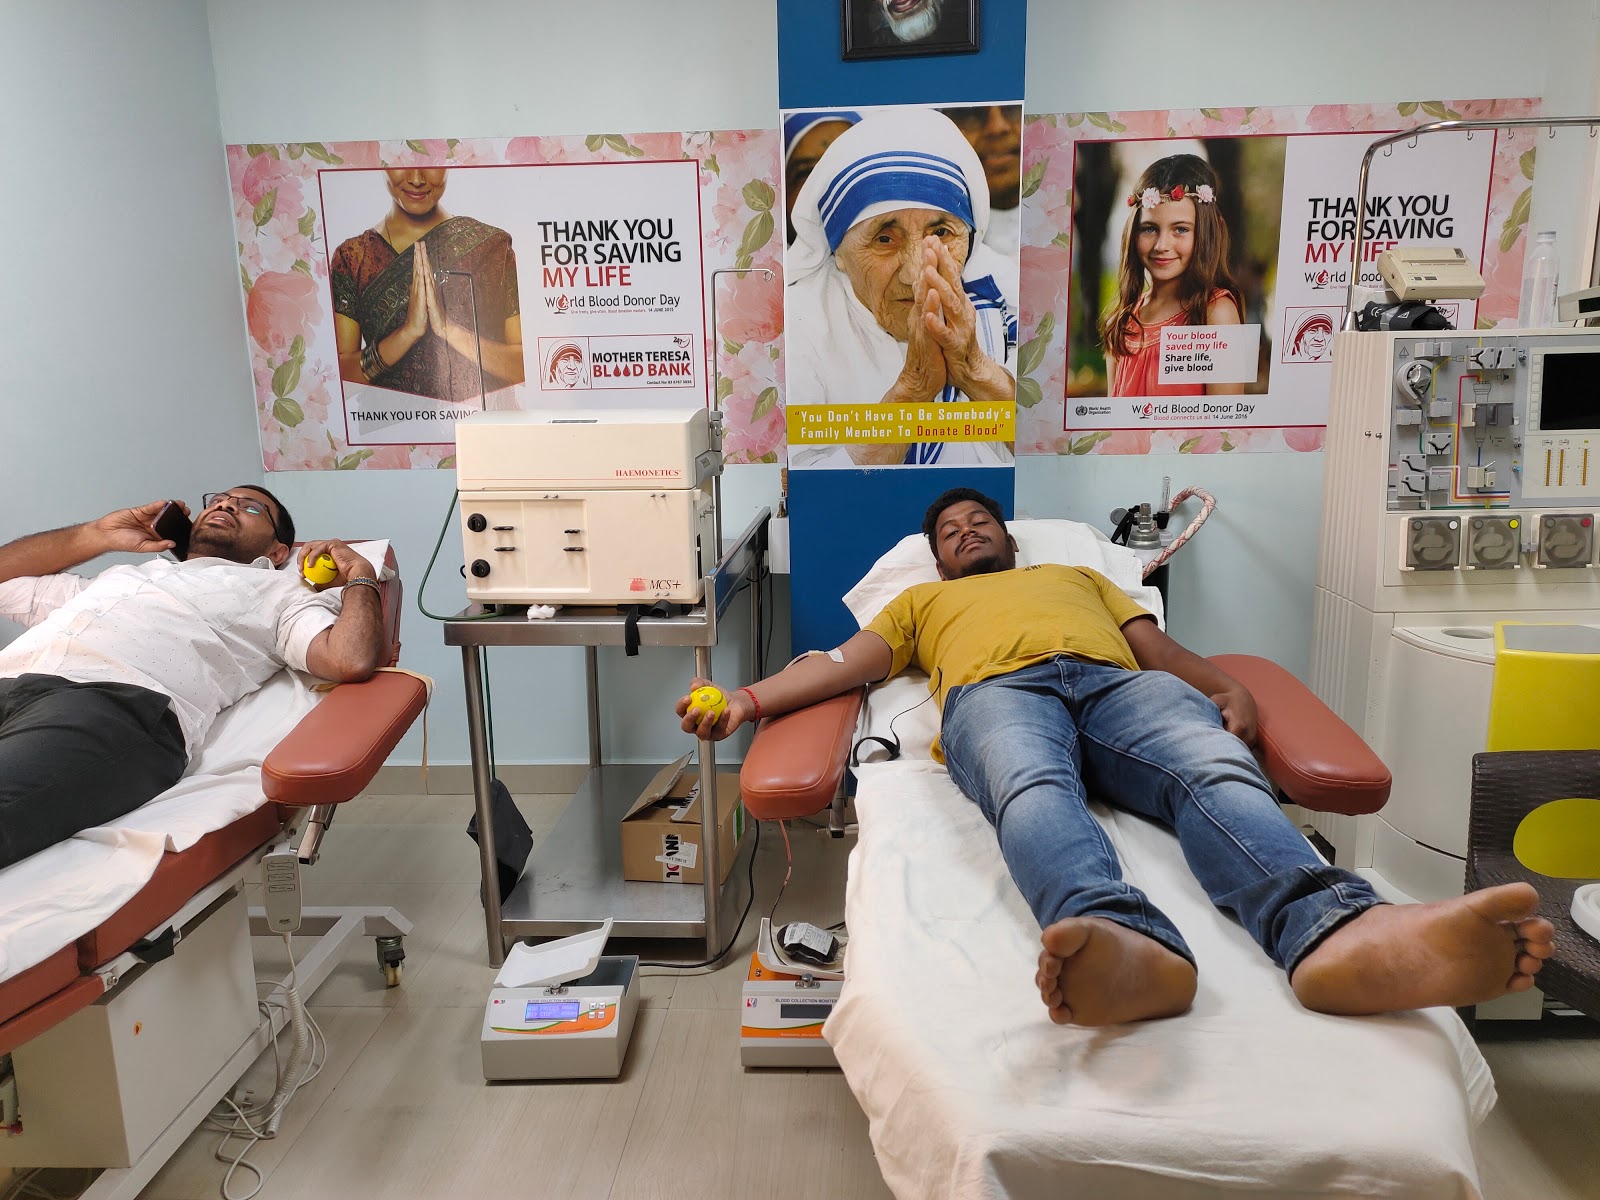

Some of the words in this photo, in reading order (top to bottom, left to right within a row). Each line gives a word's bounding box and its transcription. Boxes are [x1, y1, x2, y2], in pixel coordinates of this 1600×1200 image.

[1308, 195, 1393, 219] THANK
[1398, 194, 1449, 216] YOU
[537, 220, 620, 242] THANK
[623, 218, 673, 240] YOU
[1307, 220, 1356, 241] FOR
[1362, 217, 1454, 240] SAVING
[541, 244, 588, 265] FOR
[594, 241, 681, 264] SAVING
[1305, 242, 1344, 263] MY
[543, 266, 578, 288] MY
[585, 265, 632, 287] LIFE
[1359, 272, 1383, 282] ood
[589, 295, 620, 307] Blood
[624, 294, 656, 306] Donor
[659, 294, 681, 307] Day
[1166, 332, 1189, 341] Your
[1191, 331, 1217, 340] blood
[1165, 342, 1194, 350] saved
[1196, 343, 1210, 352] my
[1213, 341, 1228, 350] life
[592, 351, 643, 363] MOTHER
[645, 350, 690, 362] TERESA
[1165, 353, 1192, 362] Share
[1194, 352, 1212, 363] life,
[648, 362, 692, 376] BANK
[1164, 363, 1184, 374] give
[1187, 363, 1213, 372] blood
[828, 410, 859, 422] Don't
[865, 409, 894, 422] Have
[899, 409, 912, 421] To
[918, 409, 932, 421] Be
[938, 408, 1011, 422] Somebody's
[1171, 404, 1200, 414] Blood
[1203, 403, 1233, 413] Donor
[1236, 402, 1256, 415] Day
[350, 411, 388, 421] THANK
[390, 411, 413, 420] YOU
[415, 410, 437, 420] FOR
[801, 427, 839, 440] Family
[845, 426, 892, 438] Member
[898, 426, 911, 437] To
[917, 425, 958, 437] Donate
[649, 579, 681, 590] MCS+
